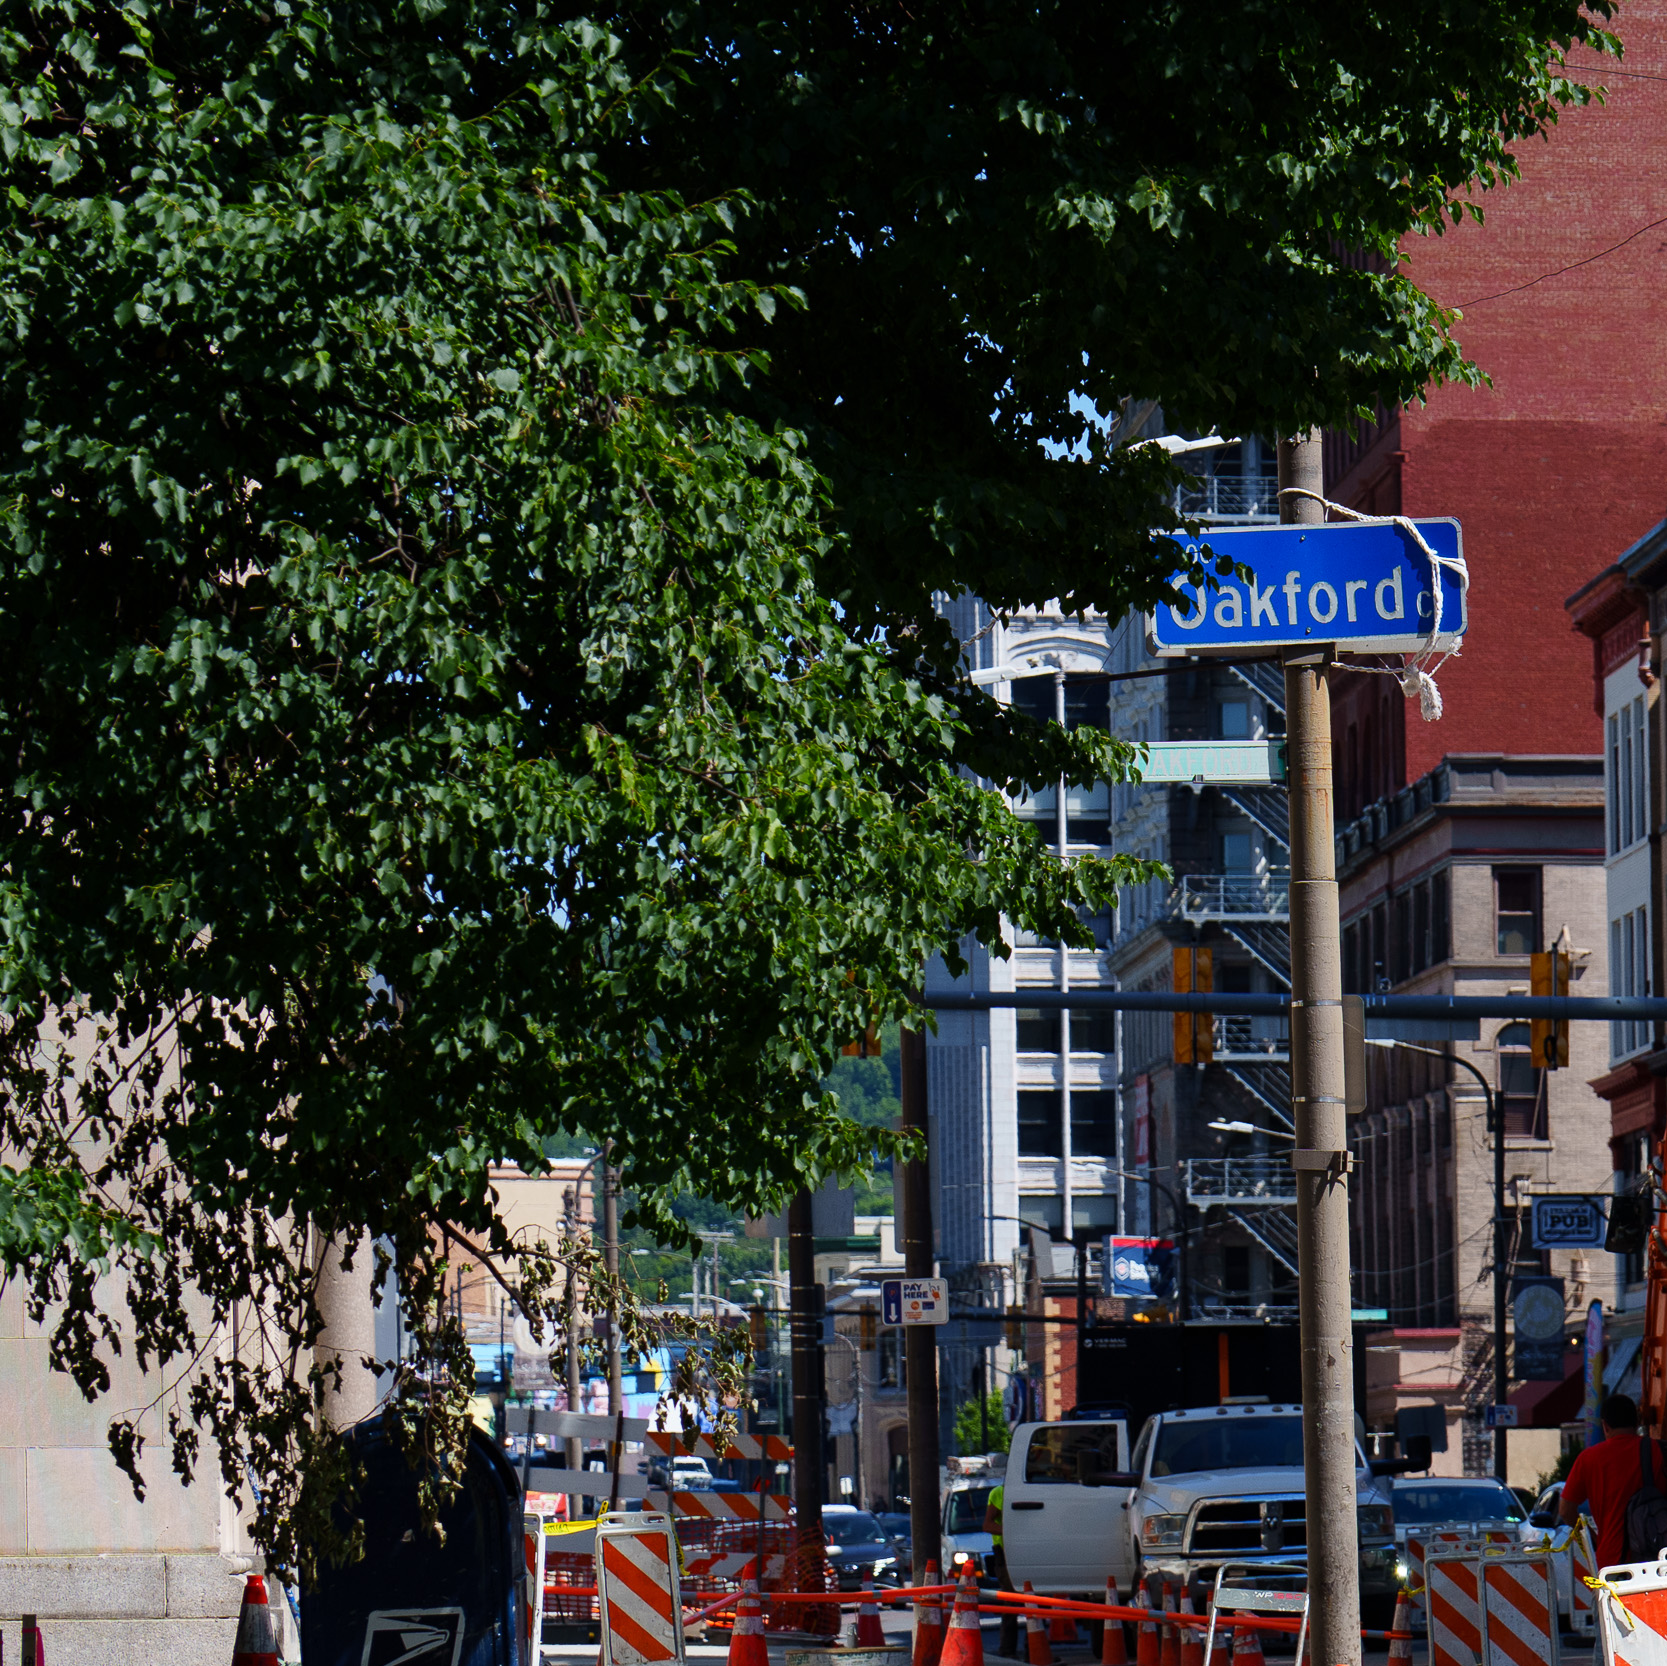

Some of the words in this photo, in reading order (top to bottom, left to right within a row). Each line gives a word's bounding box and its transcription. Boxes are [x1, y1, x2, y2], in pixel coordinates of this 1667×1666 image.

[1169, 564, 1406, 630] Oakford
[1550, 1215, 1589, 1228] PUB
[903, 1283, 922, 1292] PAY
[903, 1290, 929, 1300] HERE
